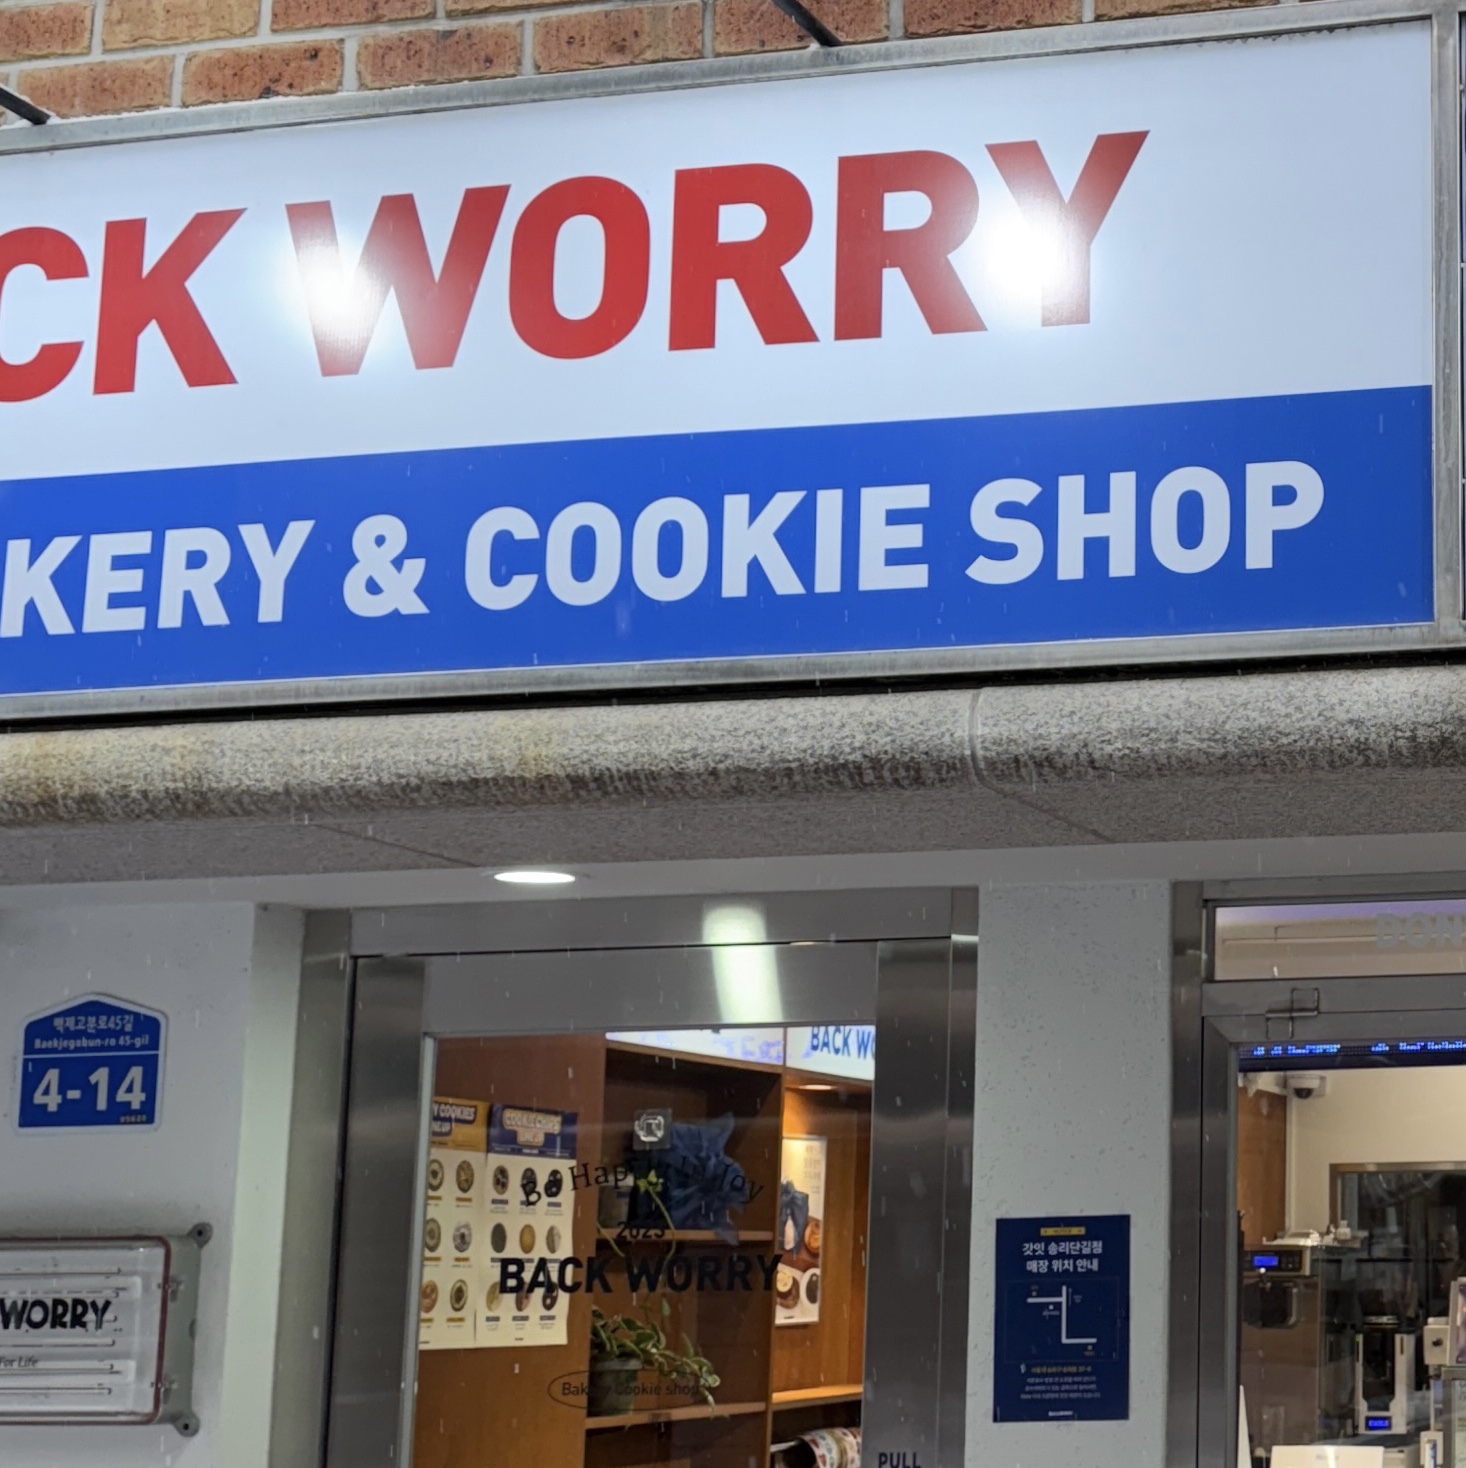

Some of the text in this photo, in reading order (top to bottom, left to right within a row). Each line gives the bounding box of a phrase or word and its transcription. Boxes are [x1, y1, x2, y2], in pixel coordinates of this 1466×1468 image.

[0, 130, 1150, 402] CK WORRY
[0, 461, 1324, 638] KERY & COOKIE SHOP
[811, 1026, 851, 1057] BACK
[32, 1066, 147, 1112] 4-14
[501, 1254, 782, 1294] BACK WORRY
[1026, 1258, 1099, 1273] 매장 위치 안내
[0, 1297, 112, 1331] WORRY
[562, 1382, 612, 1399] Baky
